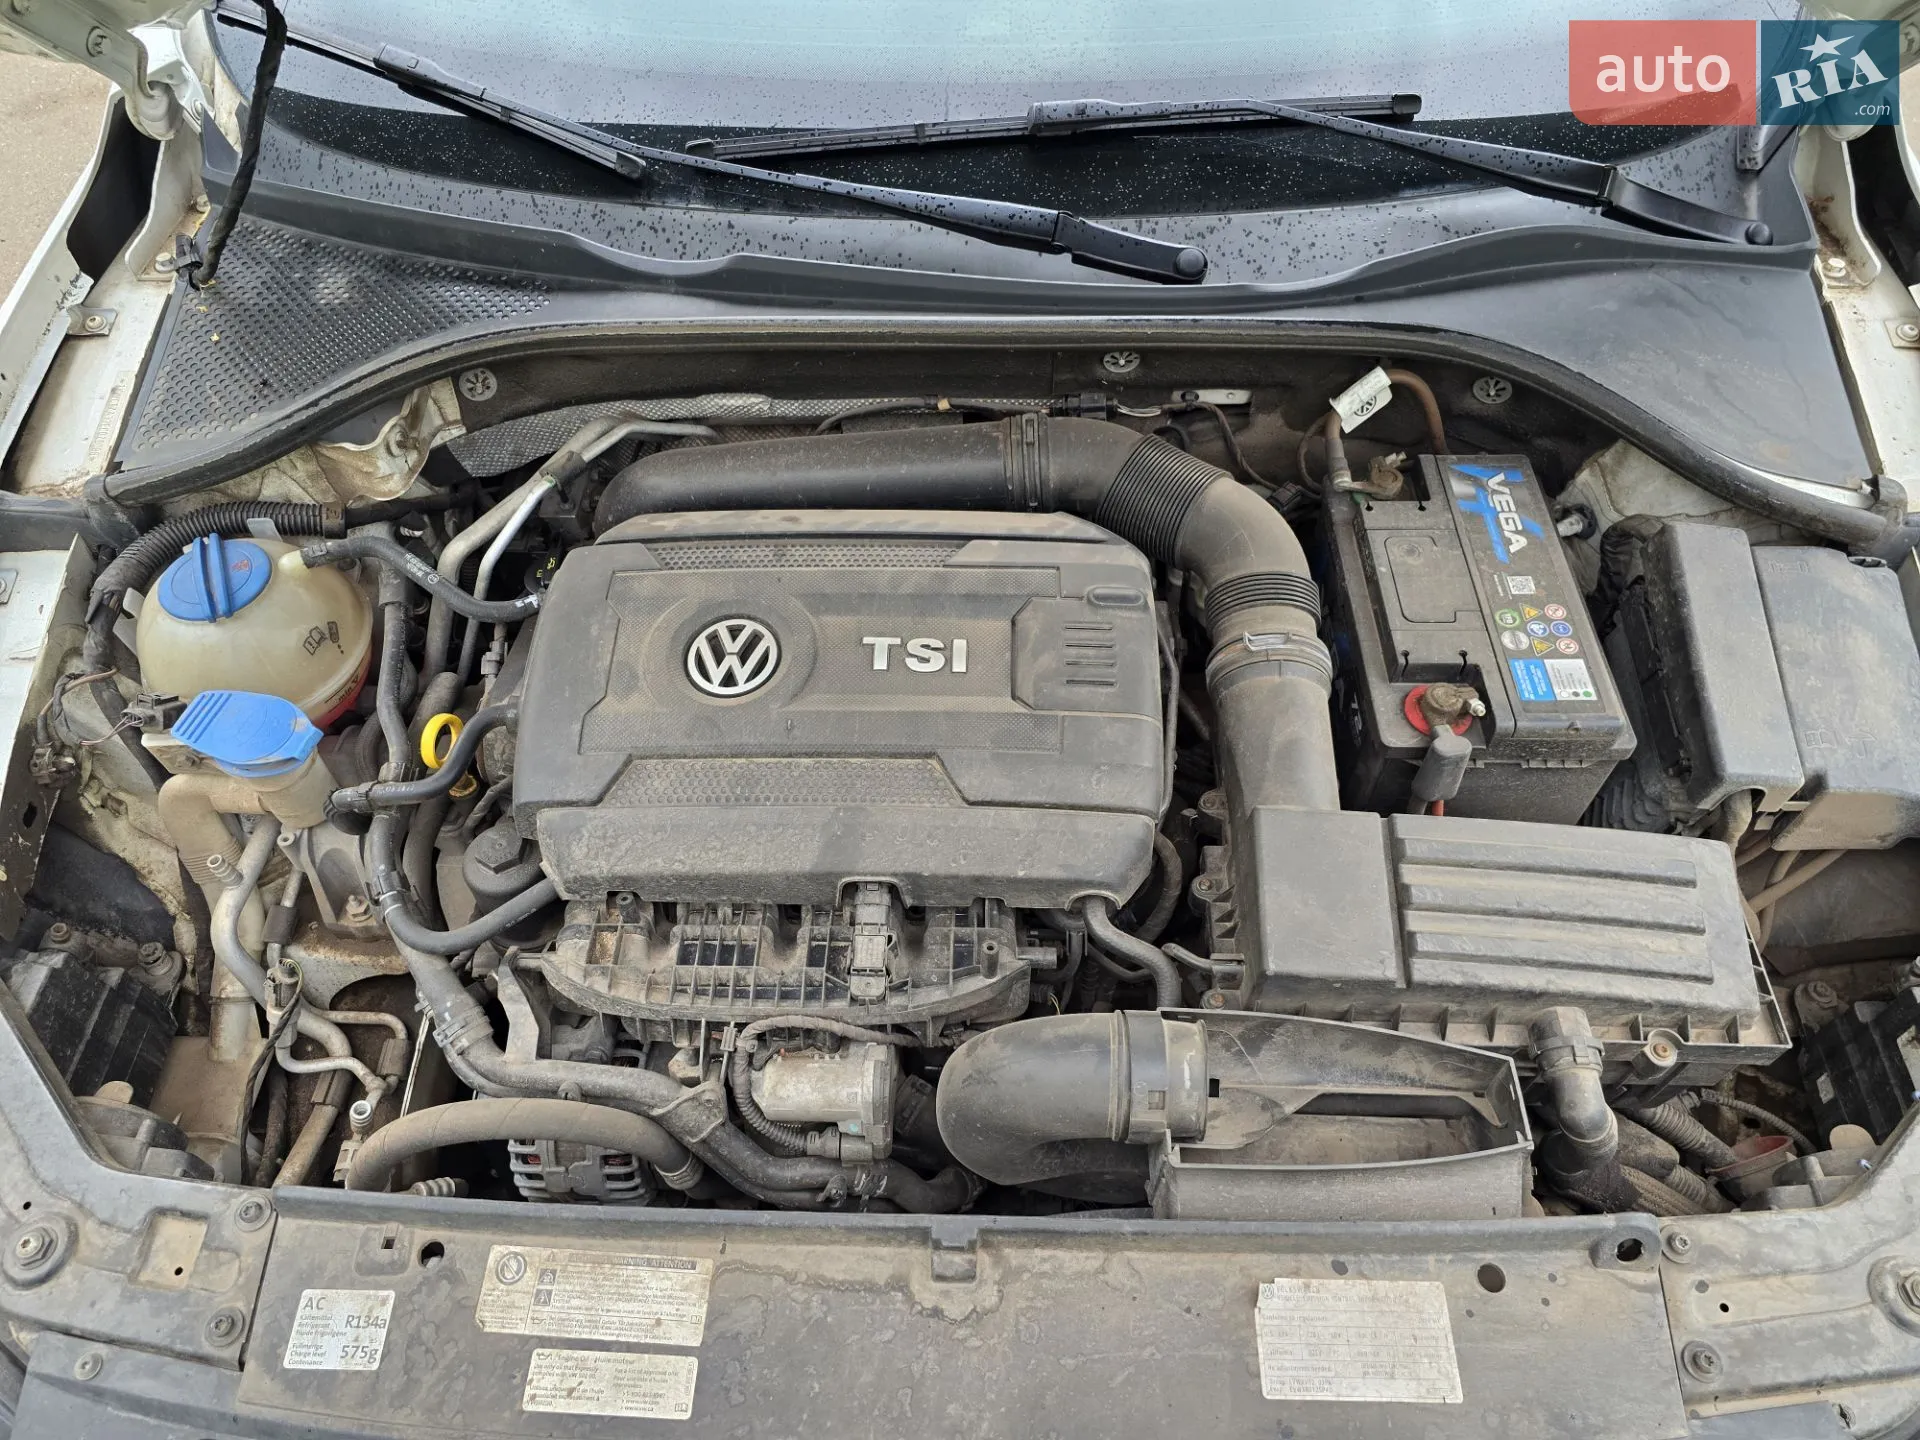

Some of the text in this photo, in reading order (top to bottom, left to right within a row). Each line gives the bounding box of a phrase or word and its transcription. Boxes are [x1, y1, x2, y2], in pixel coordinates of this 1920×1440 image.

[1487, 472, 1528, 554] VEGA
[686, 617, 782, 698] VW
[861, 636, 969, 673] TSI
[651, 1259, 692, 1269] ATTENTION
[303, 1297, 326, 1310] AC
[344, 1315, 387, 1329] R134a
[340, 1345, 379, 1364] 575g
[558, 1354, 579, 1362] Engine
